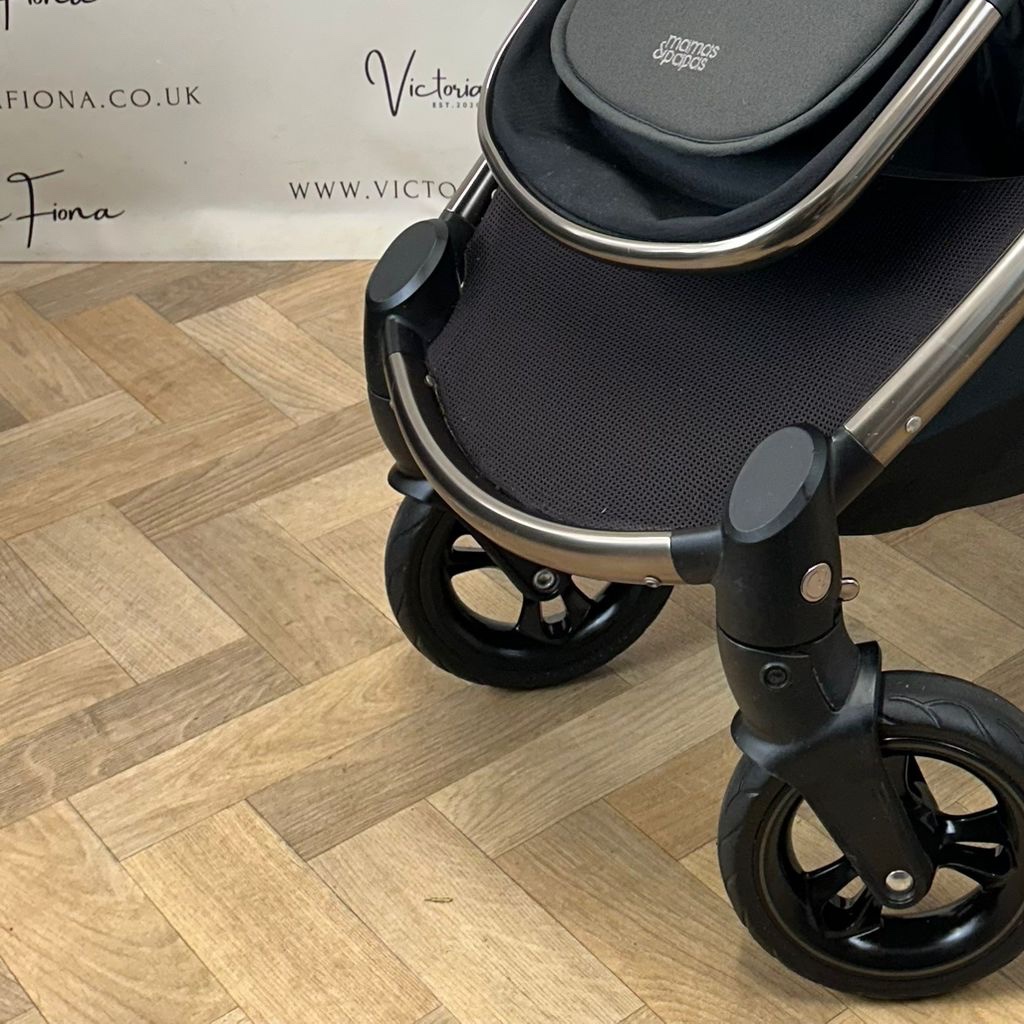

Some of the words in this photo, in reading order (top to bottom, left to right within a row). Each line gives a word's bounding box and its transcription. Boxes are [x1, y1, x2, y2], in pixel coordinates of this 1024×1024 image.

[665, 35, 720, 58] mamas
[0, 87, 201, 109] FIONA.CO.UK
[365, 49, 481, 117] Victoria
[7, 169, 125, 248] Fiona
